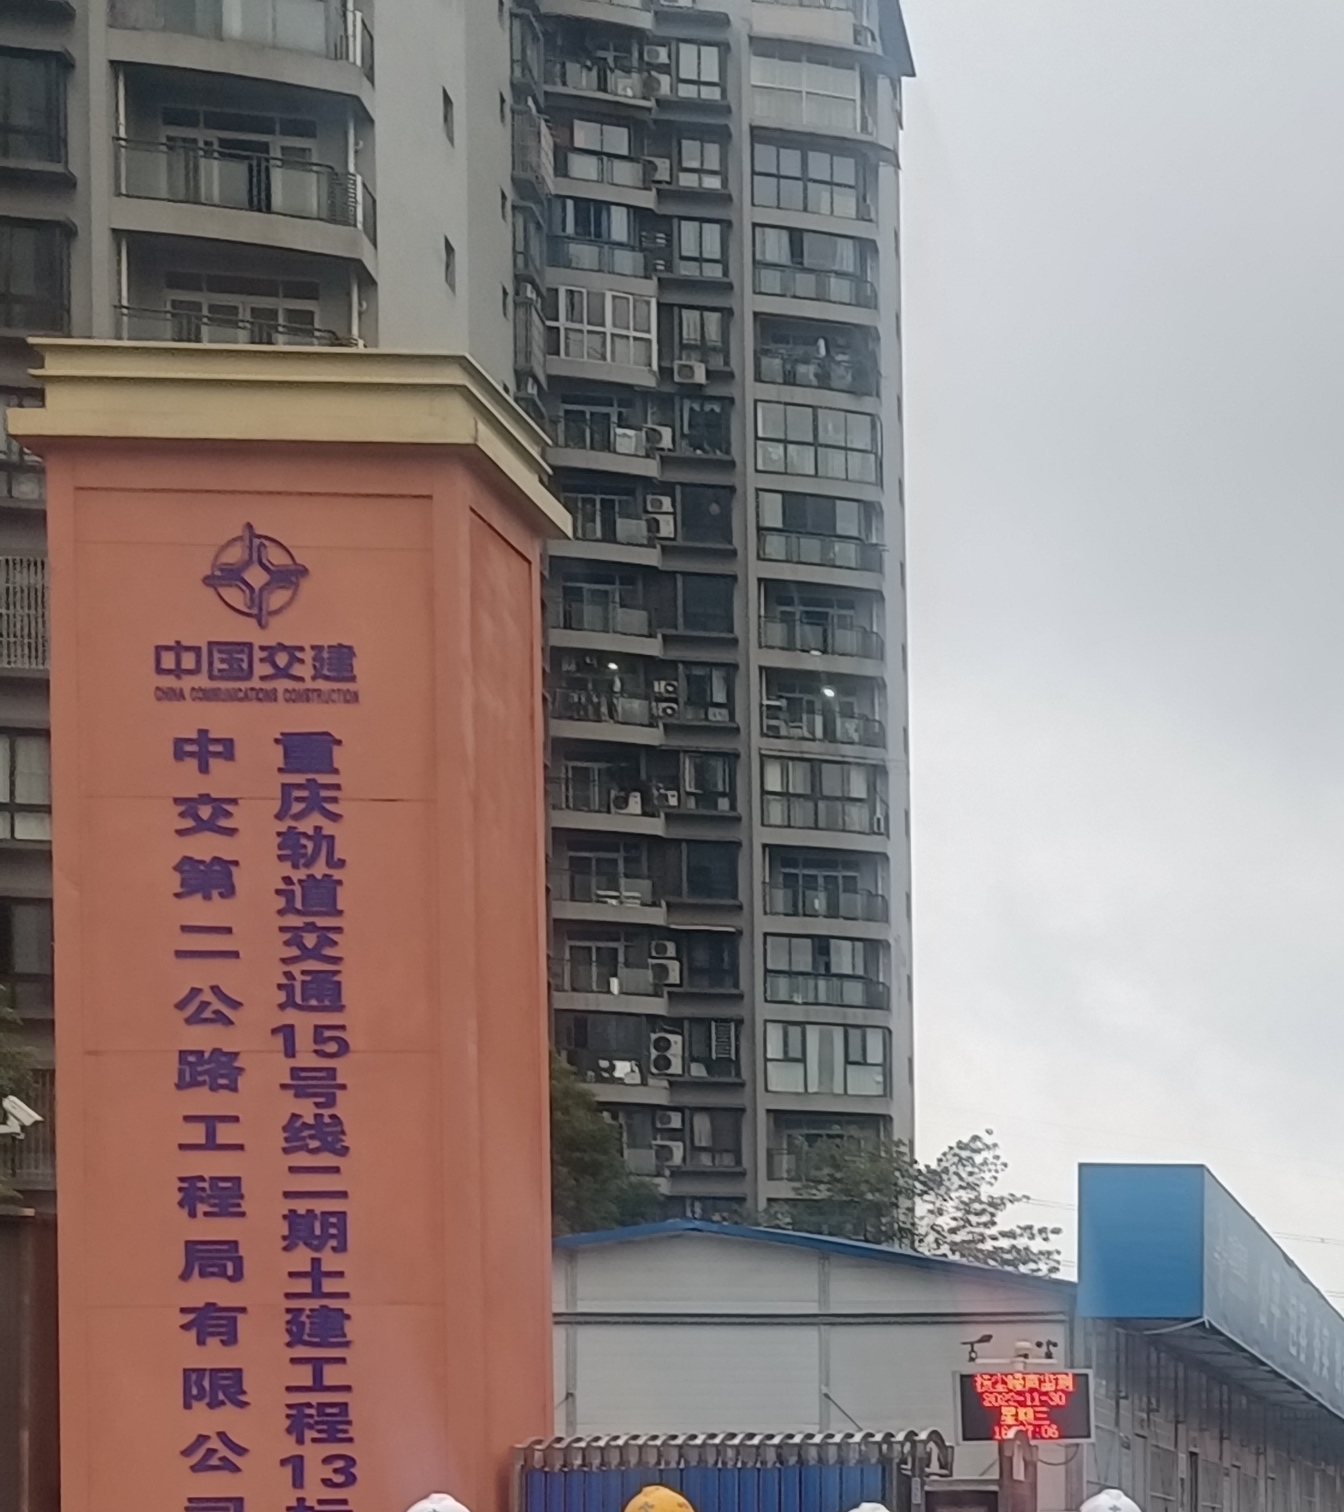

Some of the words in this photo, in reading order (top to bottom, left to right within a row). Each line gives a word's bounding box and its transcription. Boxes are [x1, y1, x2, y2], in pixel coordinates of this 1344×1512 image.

[154, 639, 357, 683] 中国交建
[154, 686, 186, 702] CHINA
[283, 688, 359, 704] CONSTRUCTION
[983, 1392, 1066, 1406] 2022-11-30
[1001, 1406, 1051, 1425] 星期三
